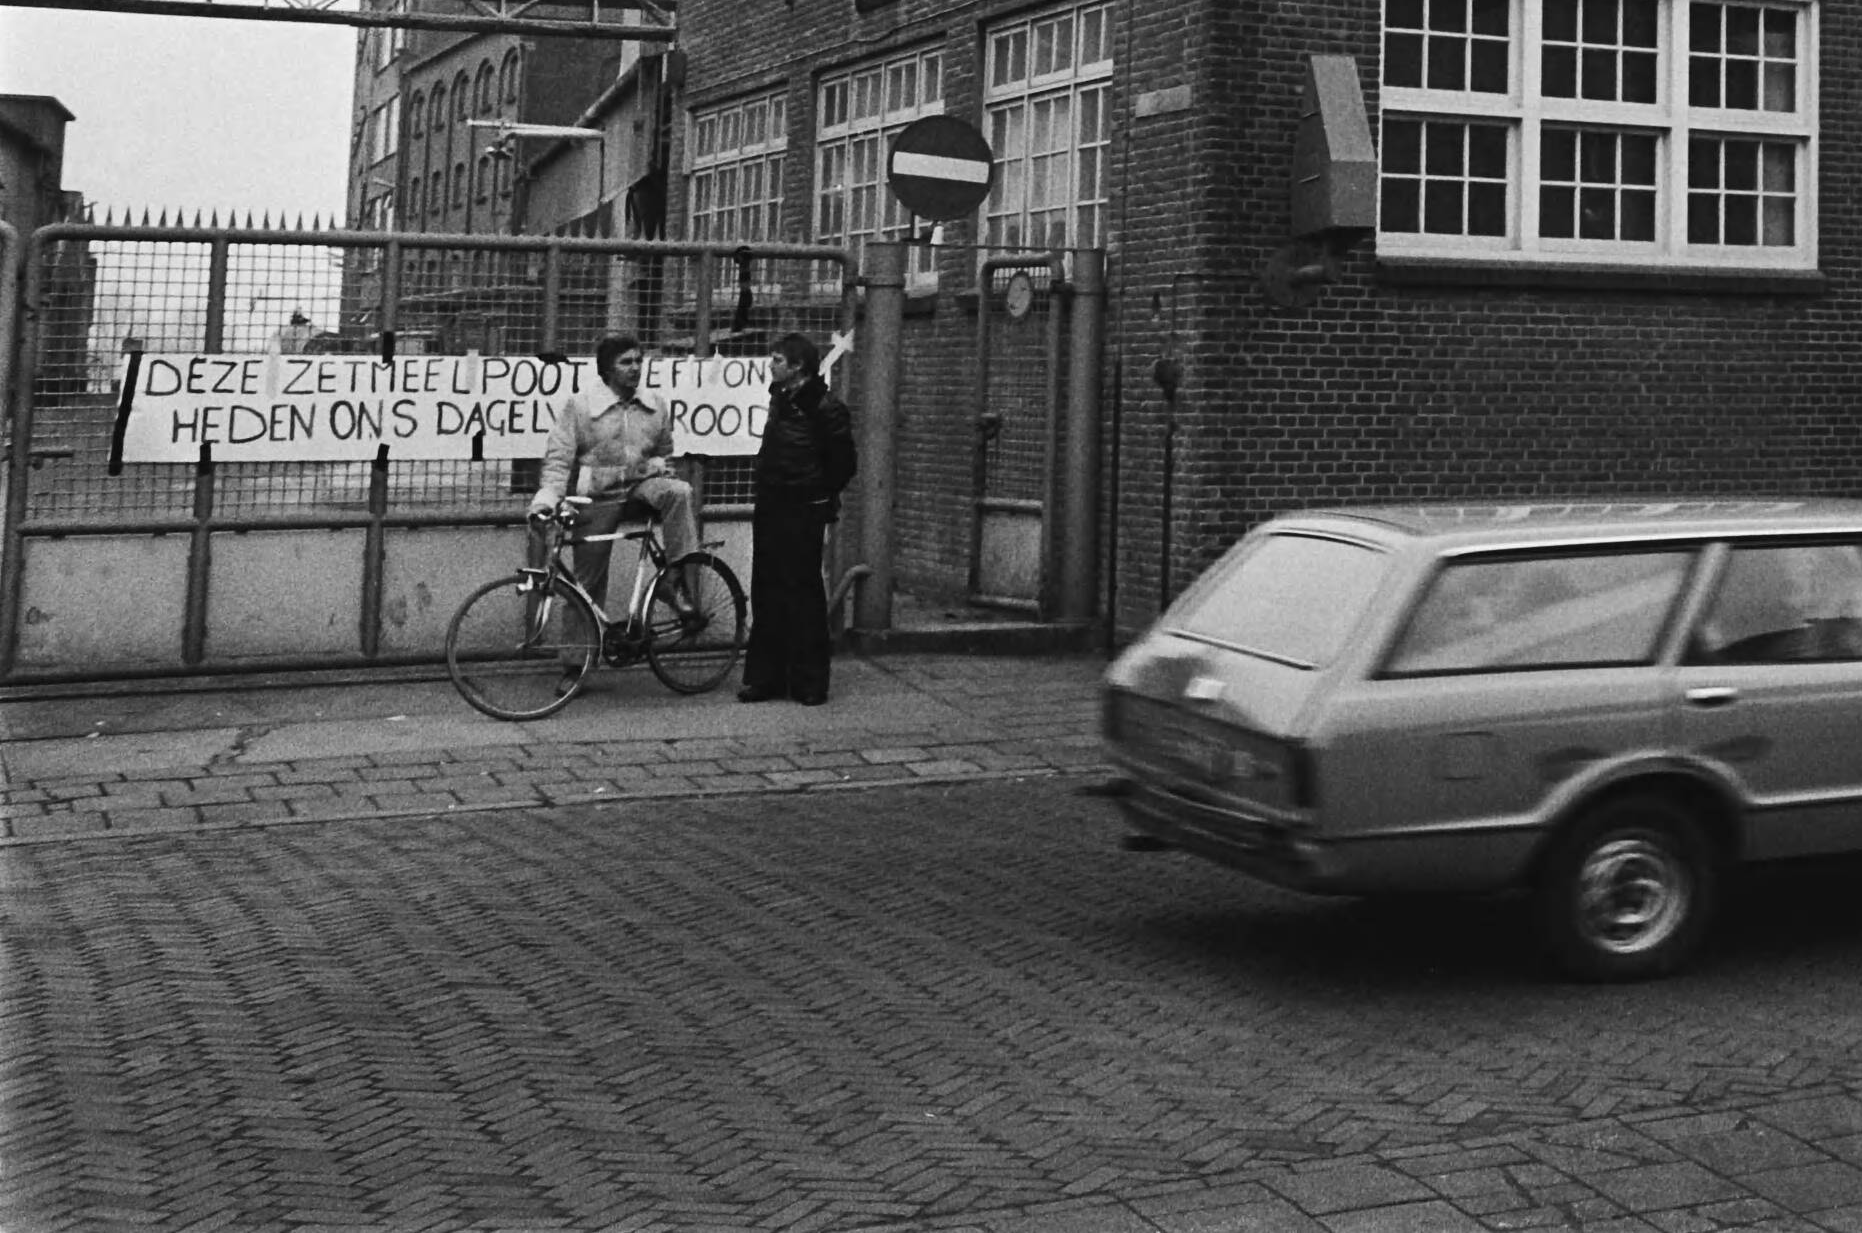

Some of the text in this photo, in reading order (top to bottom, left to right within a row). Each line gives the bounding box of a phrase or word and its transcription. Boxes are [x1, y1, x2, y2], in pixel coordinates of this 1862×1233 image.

[145, 358, 263, 396] DEZE
[723, 360, 766, 389] ON
[172, 401, 315, 444] HEDEN
[330, 399, 418, 440] ONS
[670, 399, 768, 438] ROOD
